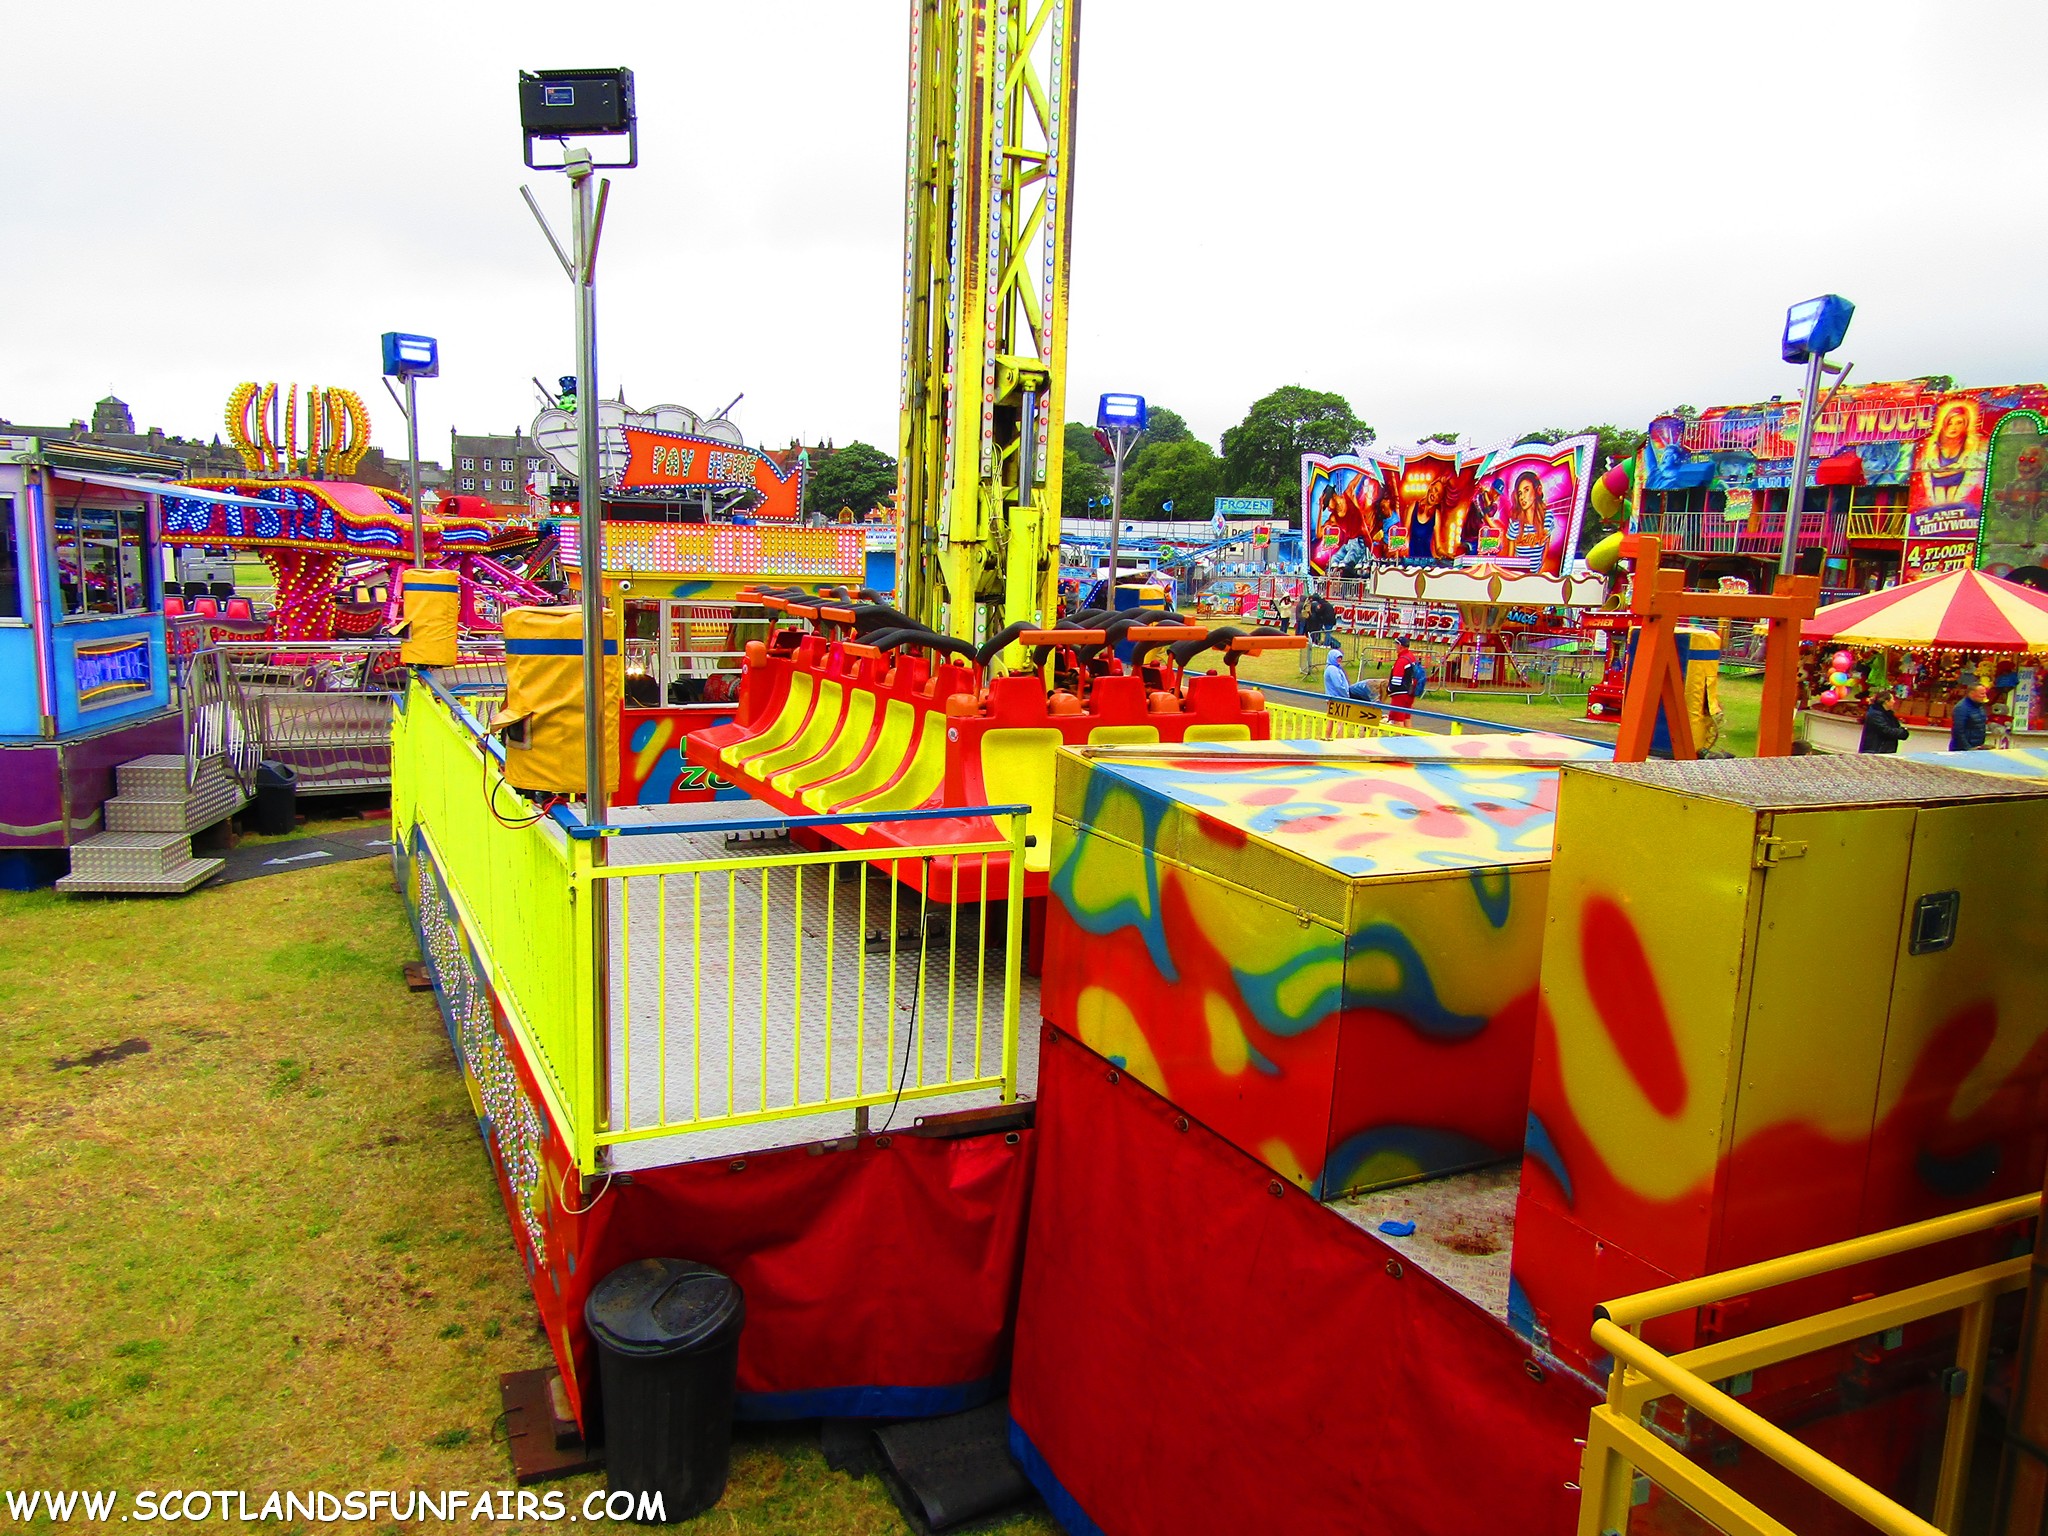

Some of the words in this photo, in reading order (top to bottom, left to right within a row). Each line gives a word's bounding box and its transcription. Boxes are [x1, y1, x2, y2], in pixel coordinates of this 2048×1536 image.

[1814, 396, 1934, 434] LLYWOOD
[652, 445, 695, 478] PAY
[707, 450, 758, 485] HERE
[1219, 500, 1269, 511] FROZEN
[1915, 508, 1966, 526] PLANET
[1907, 545, 1921, 567] 4
[1923, 542, 1975, 561] FLOORS
[1922, 561, 1939, 573] OF
[1333, 605, 1400, 626] POWR
[1507, 610, 1538, 625] ANCE
[304, 675, 313, 687] 6
[1327, 702, 1352, 718] EXIT
